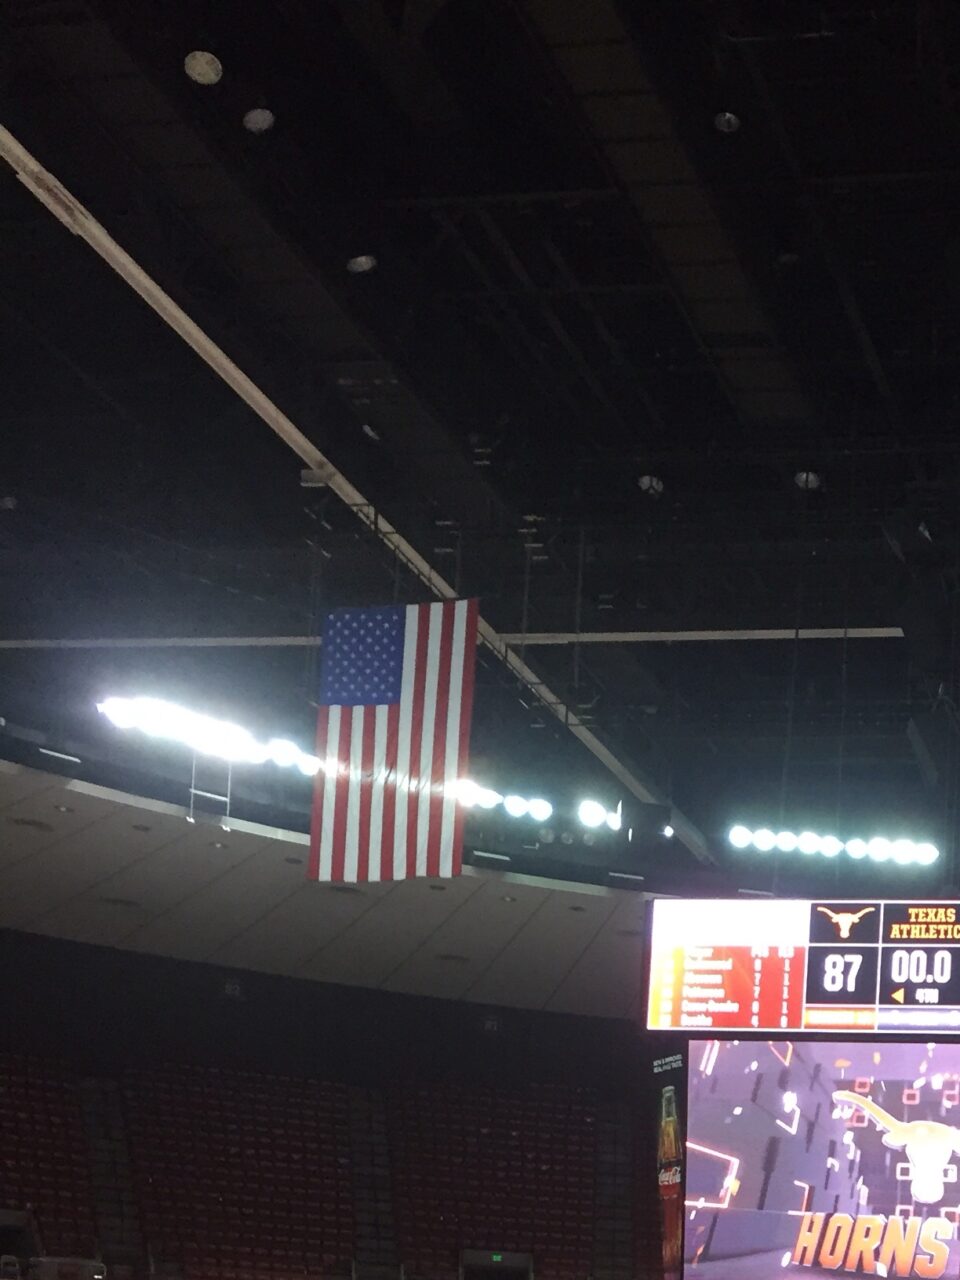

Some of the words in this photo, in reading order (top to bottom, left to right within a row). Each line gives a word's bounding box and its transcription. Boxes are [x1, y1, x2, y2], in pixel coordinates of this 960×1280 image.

[908, 908, 956, 923] TEXAS
[823, 954, 863, 992] 87
[891, 950, 952, 984] 00.0
[791, 1211, 955, 1279] HORNS
